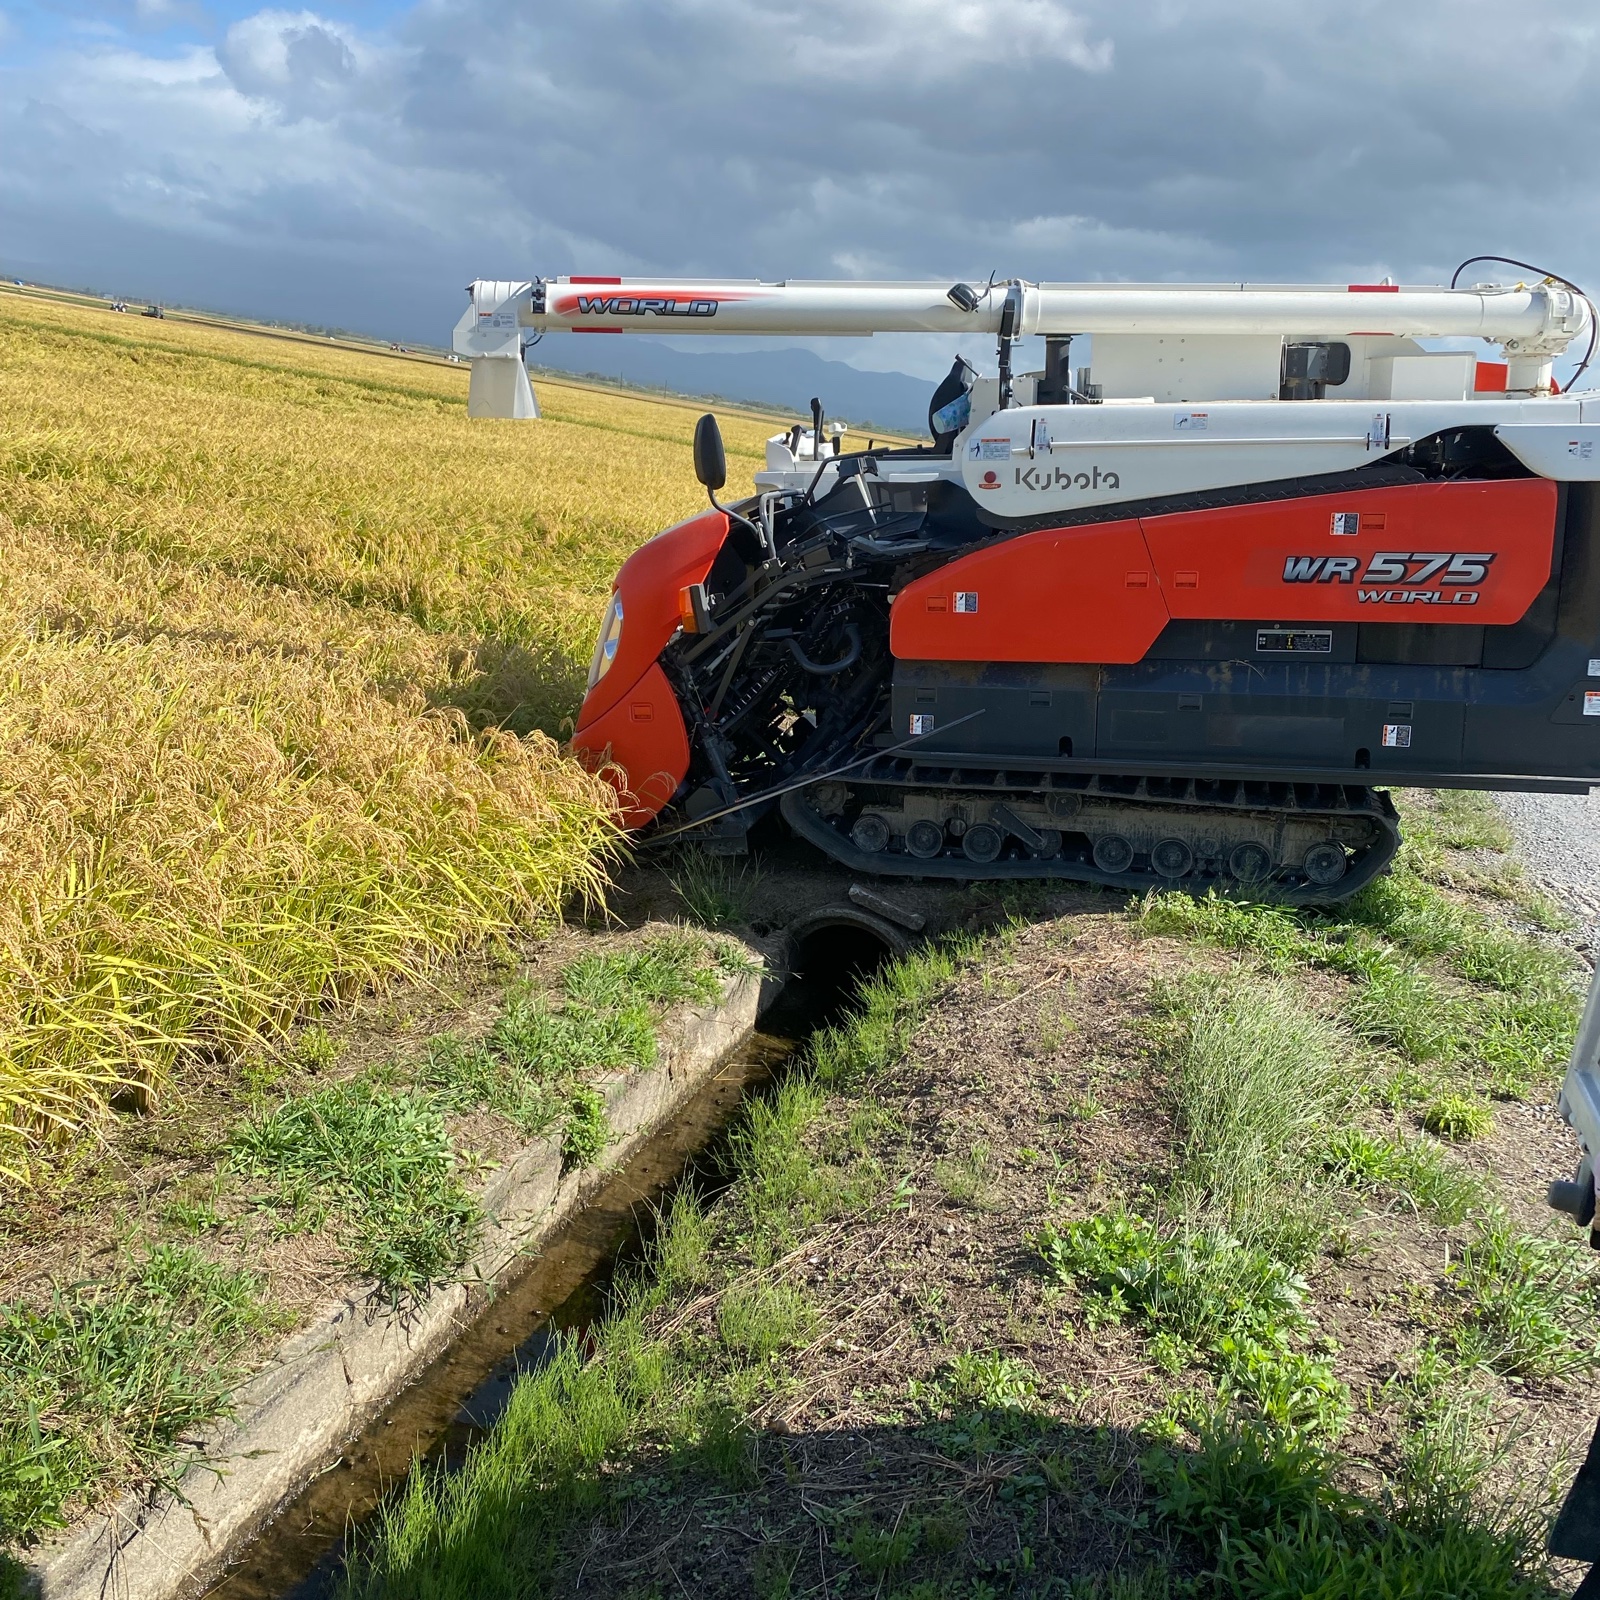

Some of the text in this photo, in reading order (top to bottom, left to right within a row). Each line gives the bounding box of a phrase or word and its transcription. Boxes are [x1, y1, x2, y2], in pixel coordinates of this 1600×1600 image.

[577, 297, 718, 317] WORLD
[1015, 465, 1120, 491] Kubota
[1282, 551, 1498, 587] WR 575
[1356, 588, 1481, 605] WORLD
